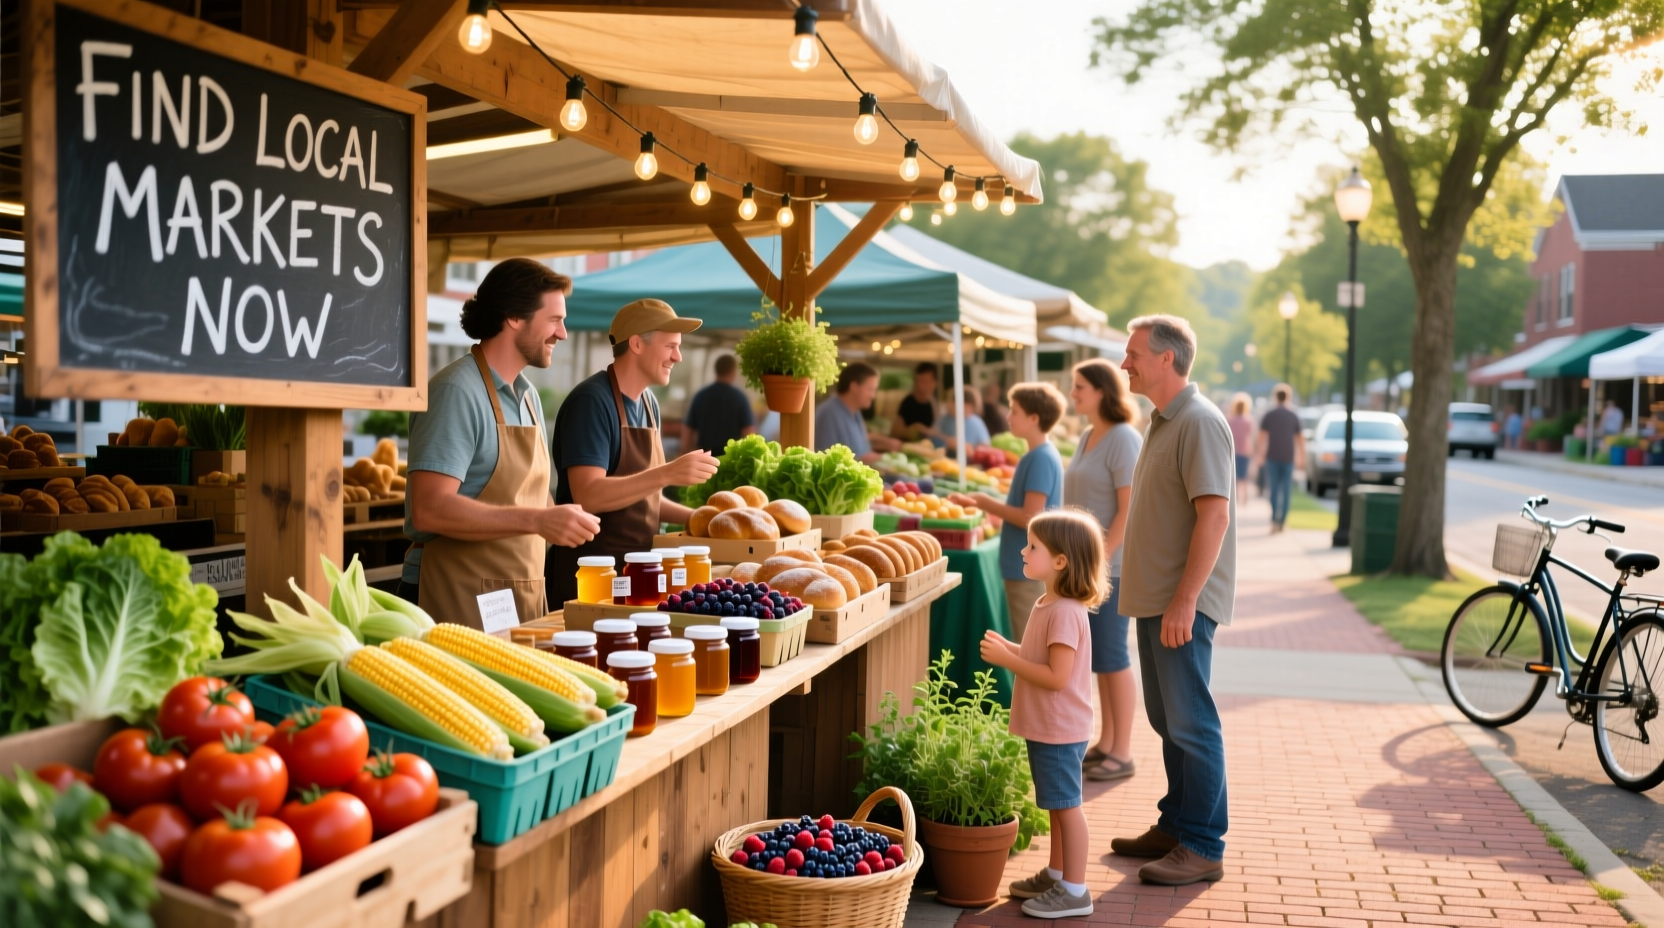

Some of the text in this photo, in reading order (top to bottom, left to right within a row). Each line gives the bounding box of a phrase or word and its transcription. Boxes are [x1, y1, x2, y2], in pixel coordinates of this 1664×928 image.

[76, 40, 394, 195] FIND LOCAL
[95, 161, 385, 288] MARKETS
[180, 276, 334, 360] NOW
